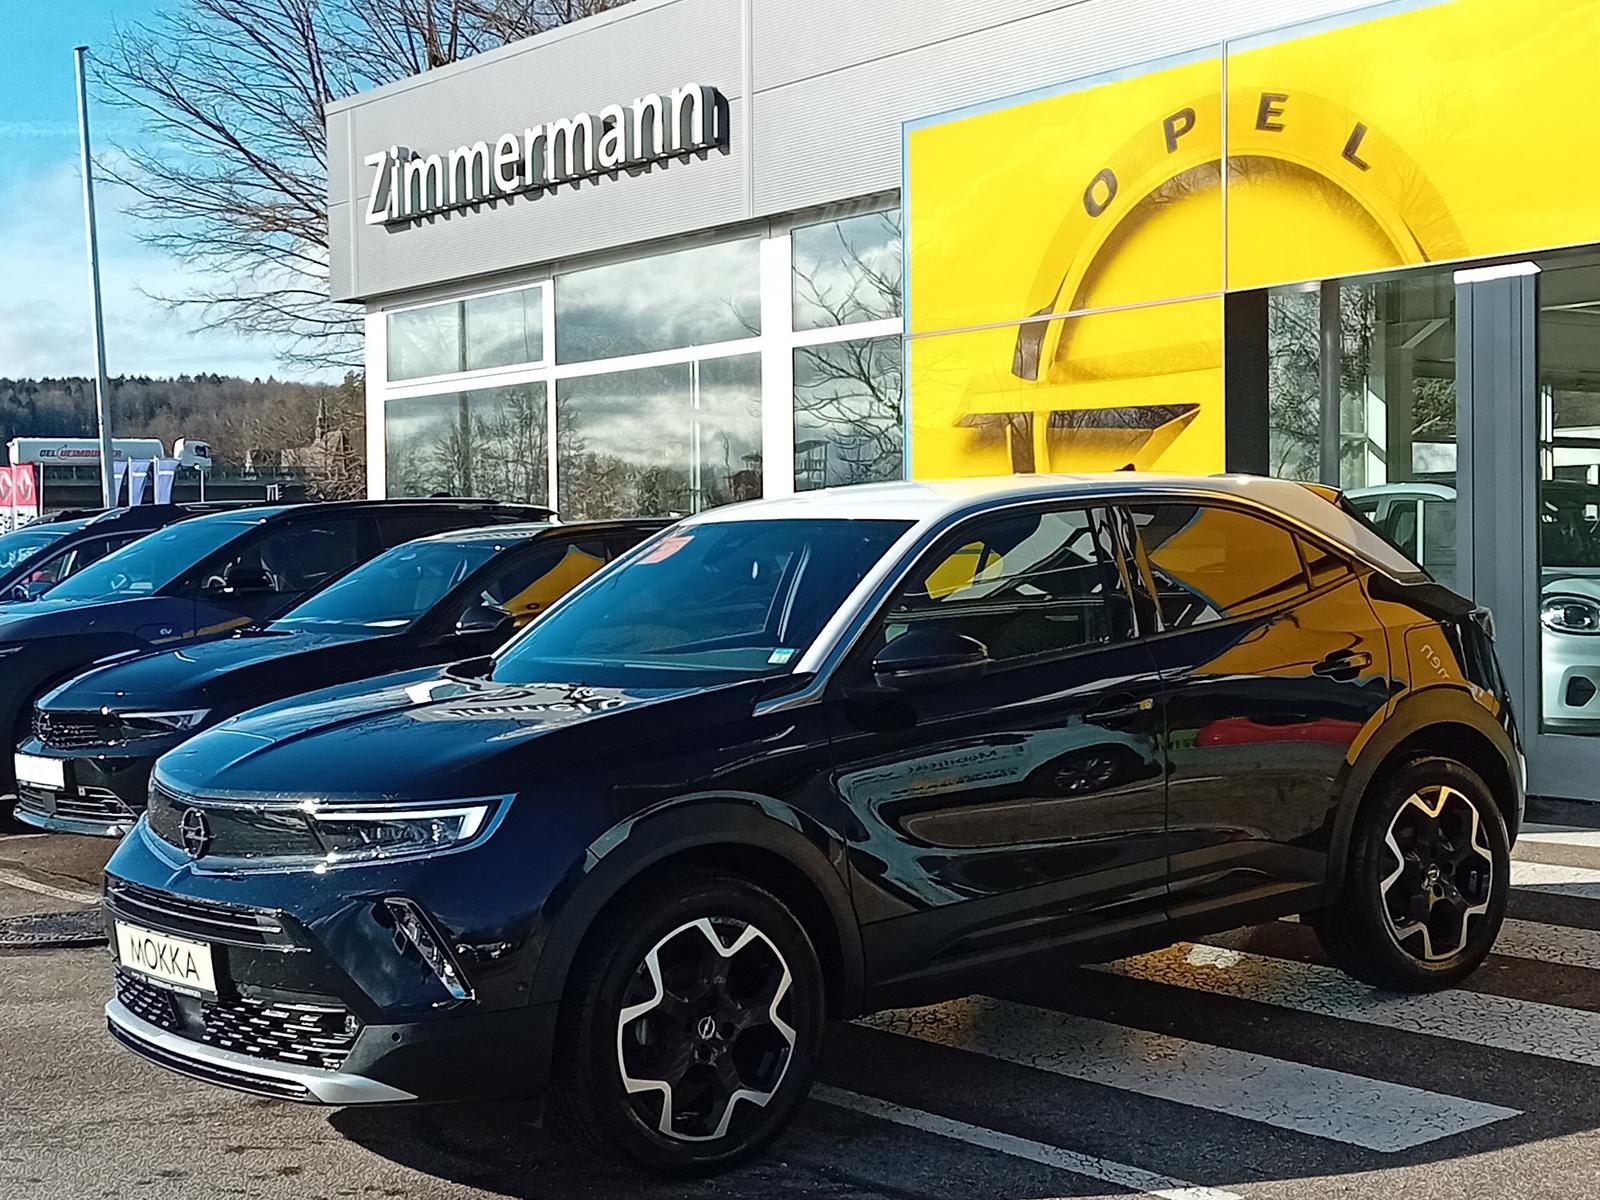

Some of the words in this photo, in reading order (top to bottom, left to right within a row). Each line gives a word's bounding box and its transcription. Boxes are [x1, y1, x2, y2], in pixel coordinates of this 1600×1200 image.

[364, 82, 729, 225] Zimmermann
[1083, 92, 1372, 218] OPEL
[129, 935, 201, 981] MOKKA
